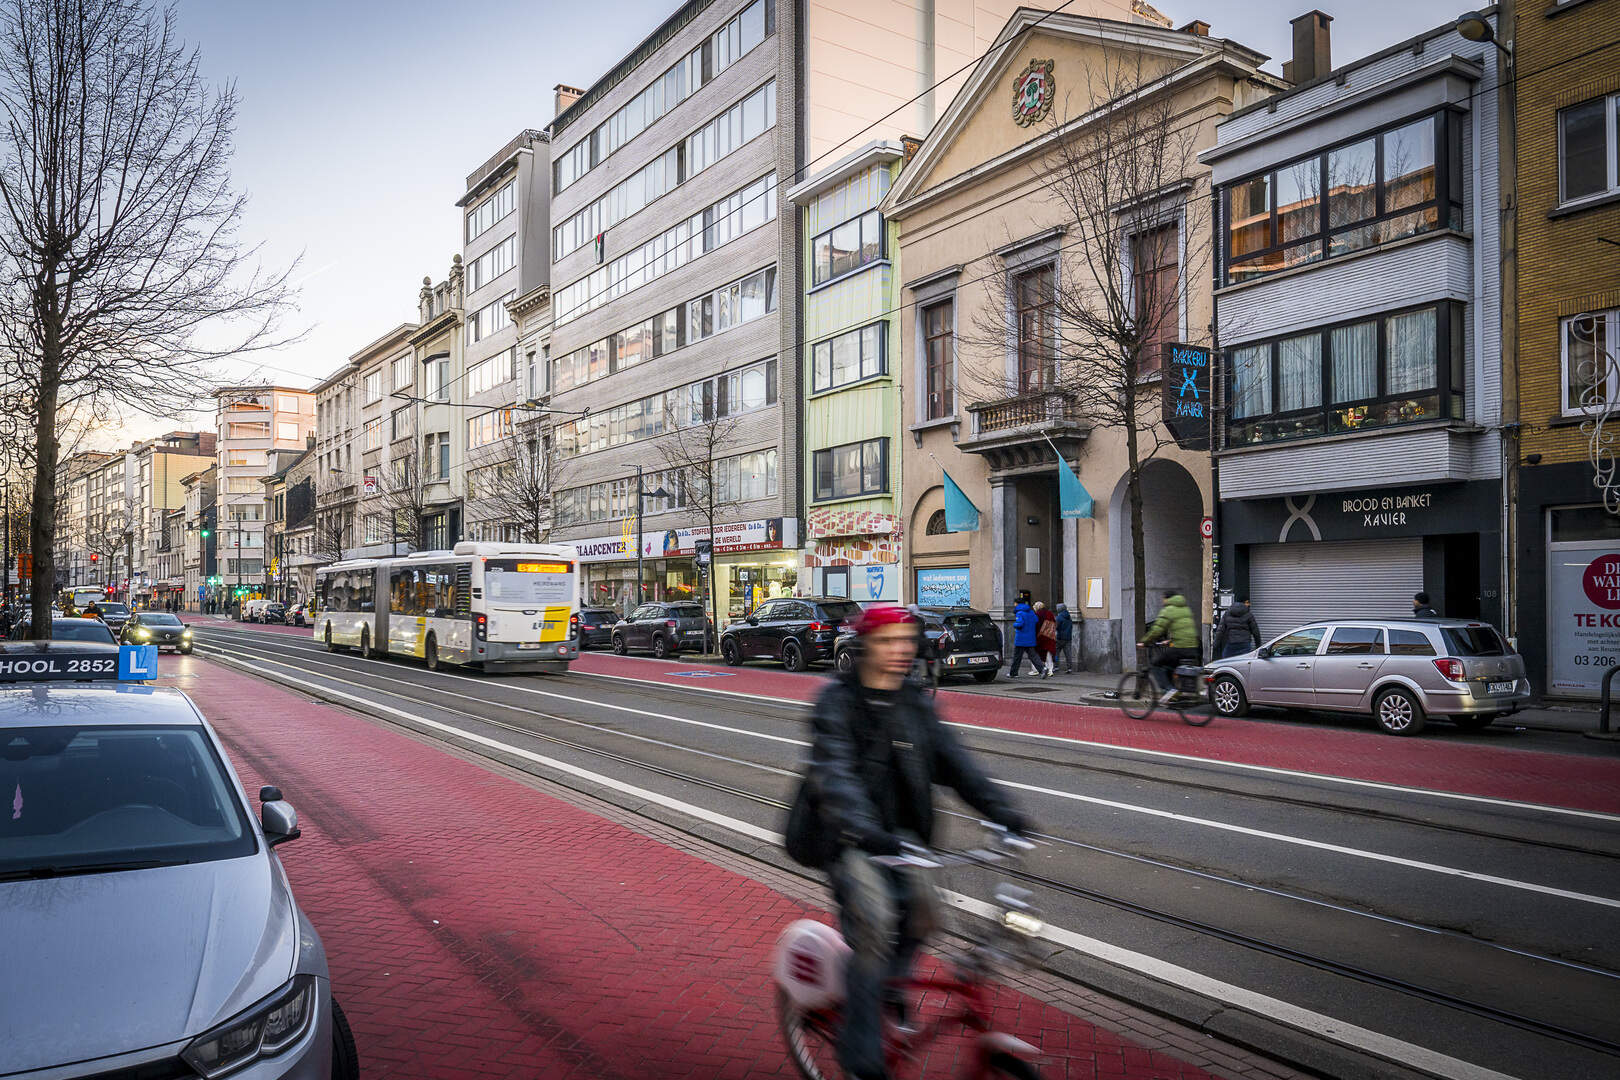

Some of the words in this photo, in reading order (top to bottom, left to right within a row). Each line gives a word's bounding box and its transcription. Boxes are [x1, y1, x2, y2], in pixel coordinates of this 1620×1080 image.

[1176, 400, 1203, 418] XAVIER
[1343, 498, 1378, 512] BROOD
[1382, 497, 1393, 509] EN
[1396, 493, 1432, 509] BANKET
[1363, 512, 1407, 527] XAVIER
[691, 528, 711, 536] STOFFEN
[724, 523, 747, 533] IEDEREEN
[722, 535, 741, 543] WERELD
[576, 541, 626, 557] SLAAPCENTER
[1574, 613, 1597, 628] TE
[0, 660, 61, 673] HOOL
[67, 659, 115, 672] 2852
[129, 651, 148, 674] L
[1574, 655, 1589, 666] 03
[1593, 656, 1616, 667] 206
